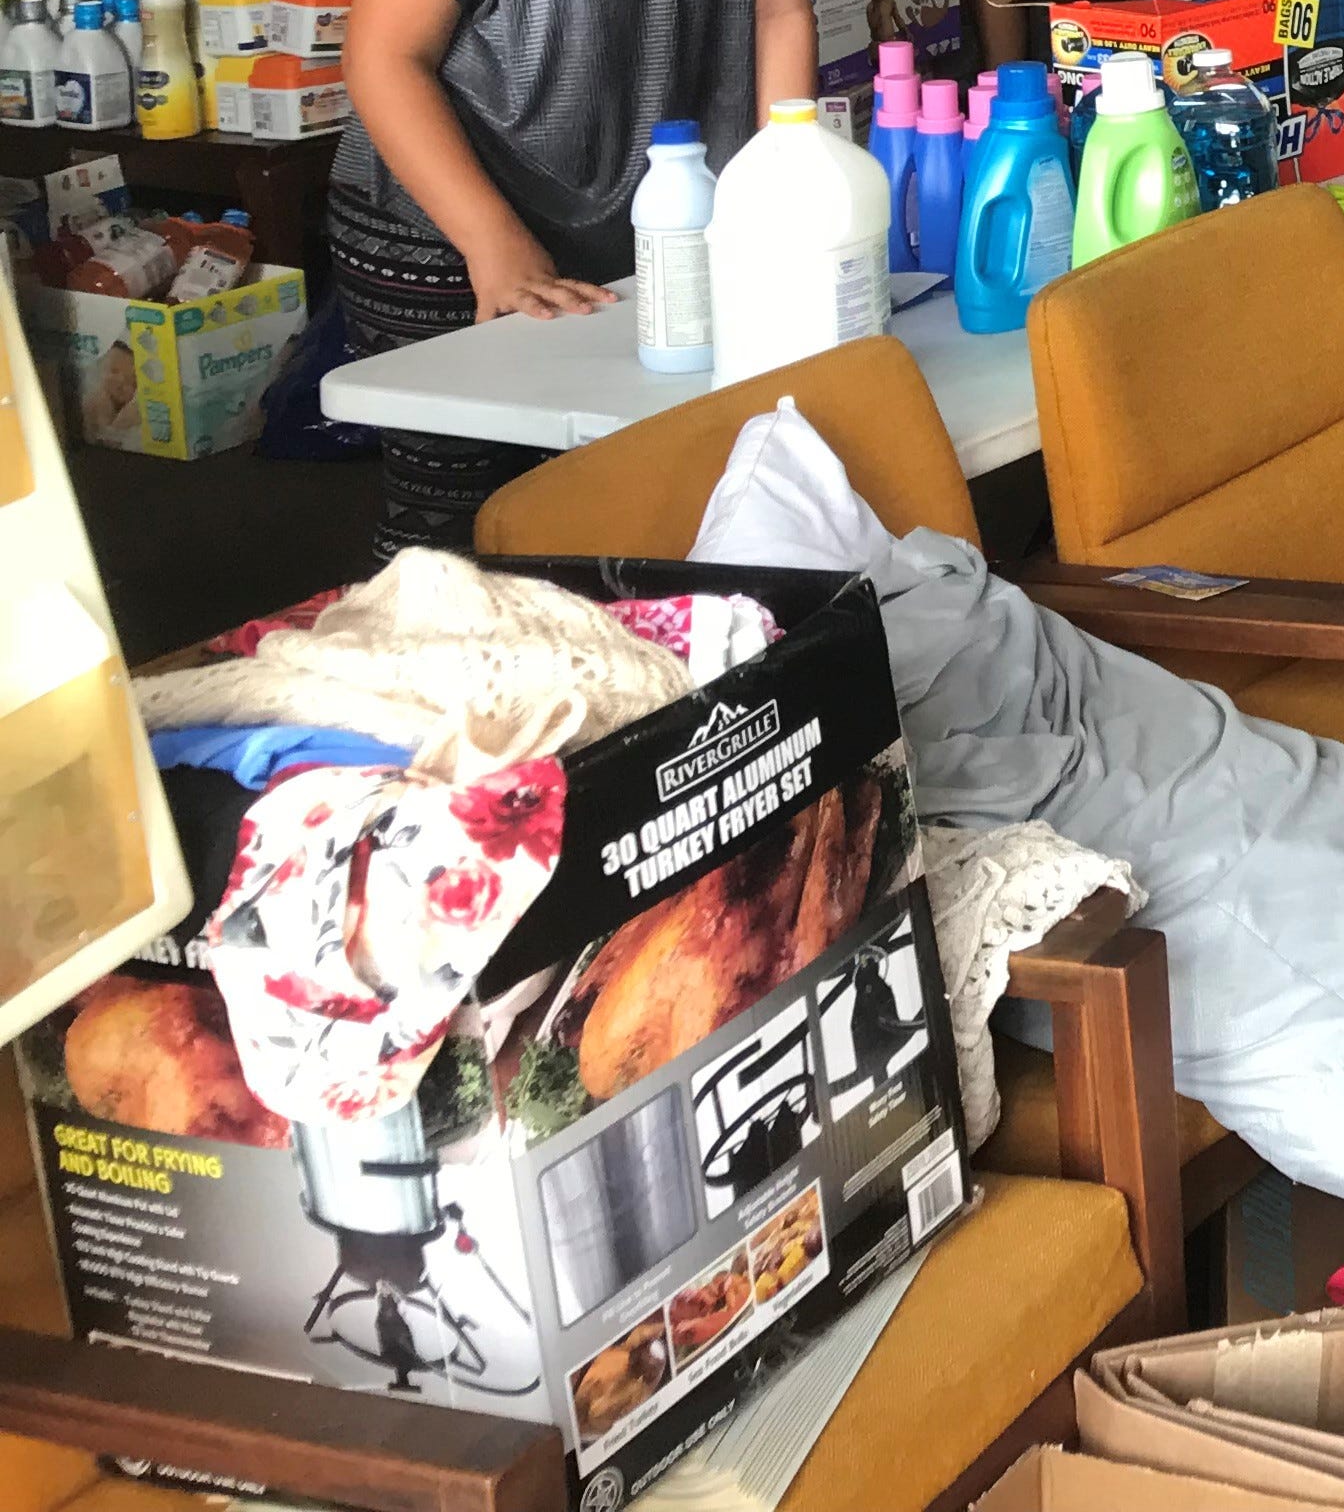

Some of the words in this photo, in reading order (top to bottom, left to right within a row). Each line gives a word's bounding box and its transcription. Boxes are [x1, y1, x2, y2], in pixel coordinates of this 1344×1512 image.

[1290, 1, 1312, 41] 90
[1299, 69, 1321, 85] ACTION
[833, 118, 841, 129] 3
[199, 344, 272, 378] Pampers
[601, 832, 638, 876] 30
[640, 785, 718, 854] QUART
[723, 716, 822, 809] ALUMINUM
[624, 821, 716, 898] TURKEY
[718, 782, 780, 845] FRYER
[781, 756, 813, 803] SET
[54, 1124, 107, 1156] GREAT
[111, 1137, 150, 1165] FOR
[153, 1146, 224, 1179] FRYING
[59, 1150, 95, 1176] AND
[96, 1158, 173, 1194] BOILING
